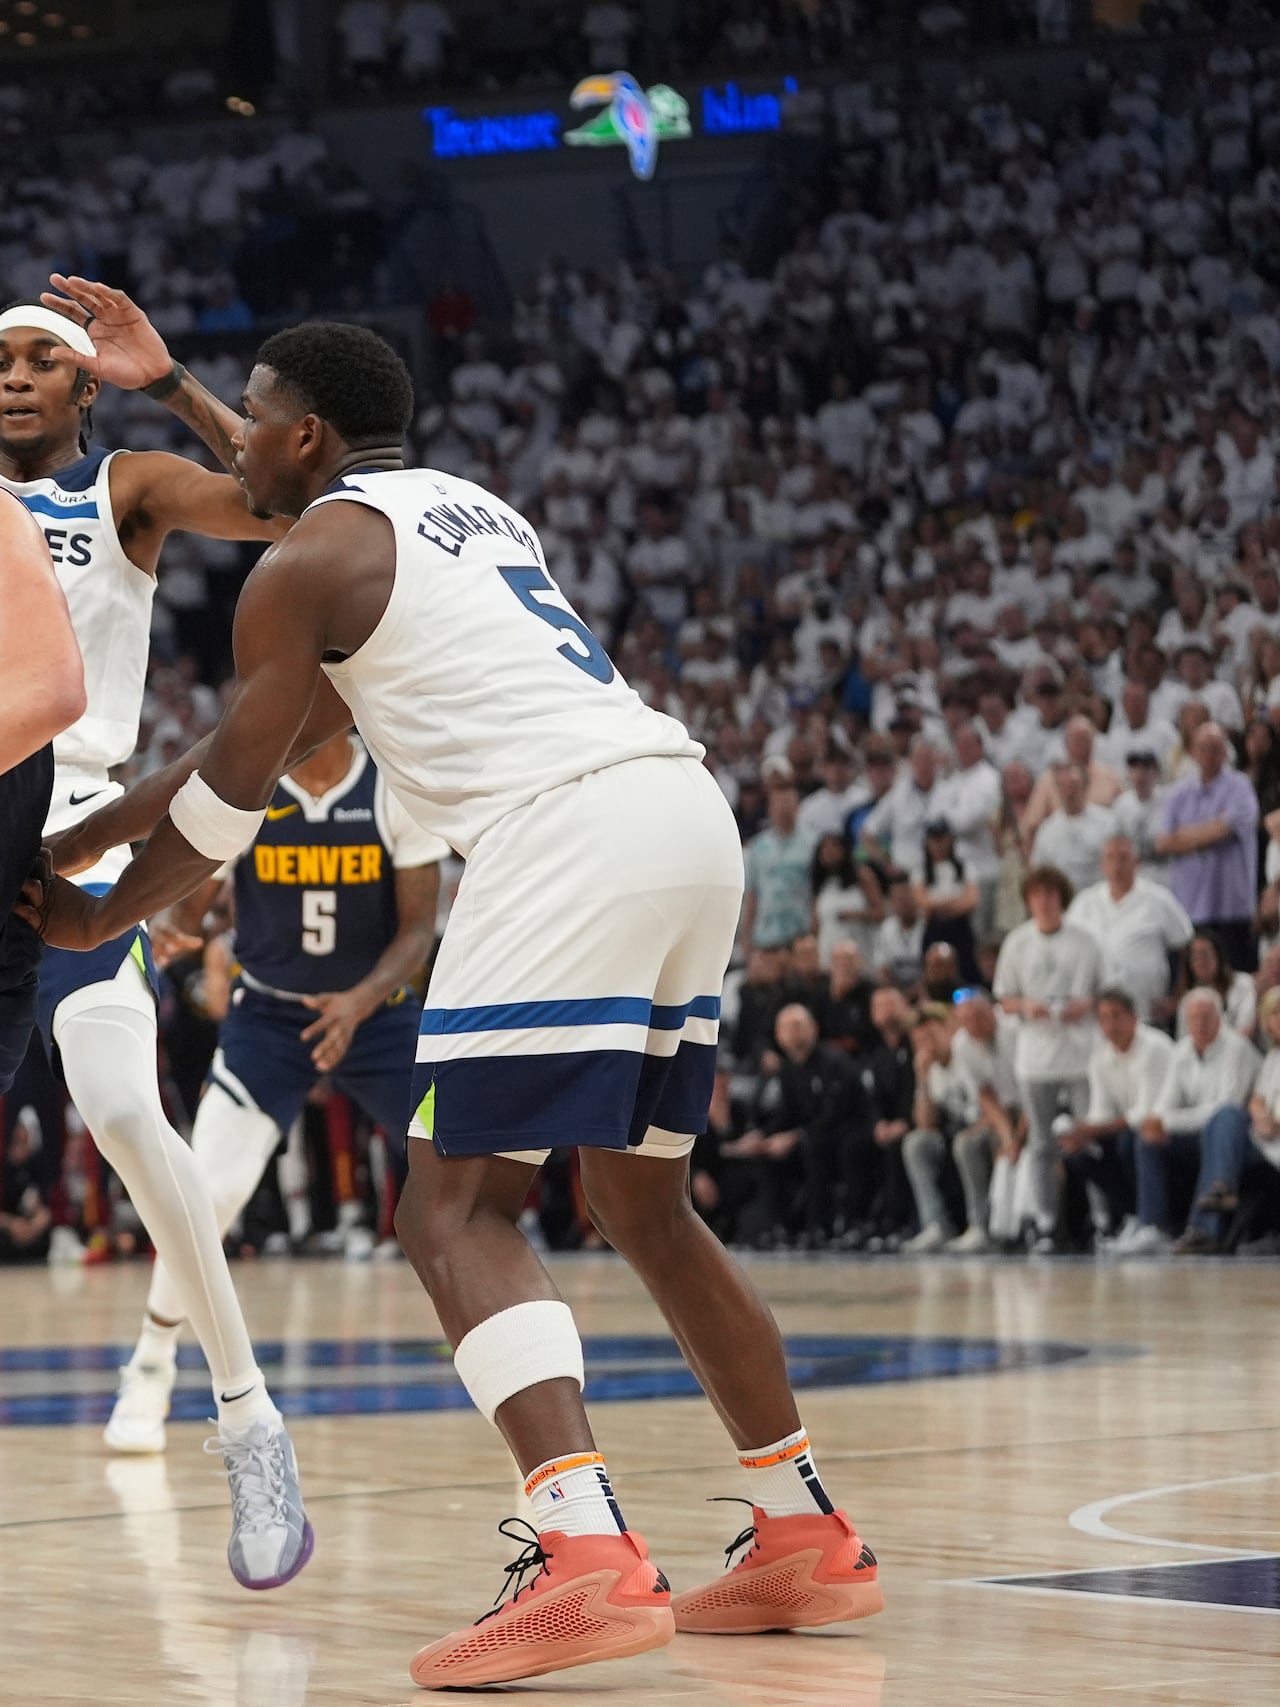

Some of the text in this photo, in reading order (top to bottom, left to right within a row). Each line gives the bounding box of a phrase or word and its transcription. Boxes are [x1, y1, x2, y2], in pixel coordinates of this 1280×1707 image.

[703, 75, 799, 136] Islan
[496, 565, 615, 684] 5
[254, 844, 382, 885] DENVER
[301, 889, 337, 956] 5
